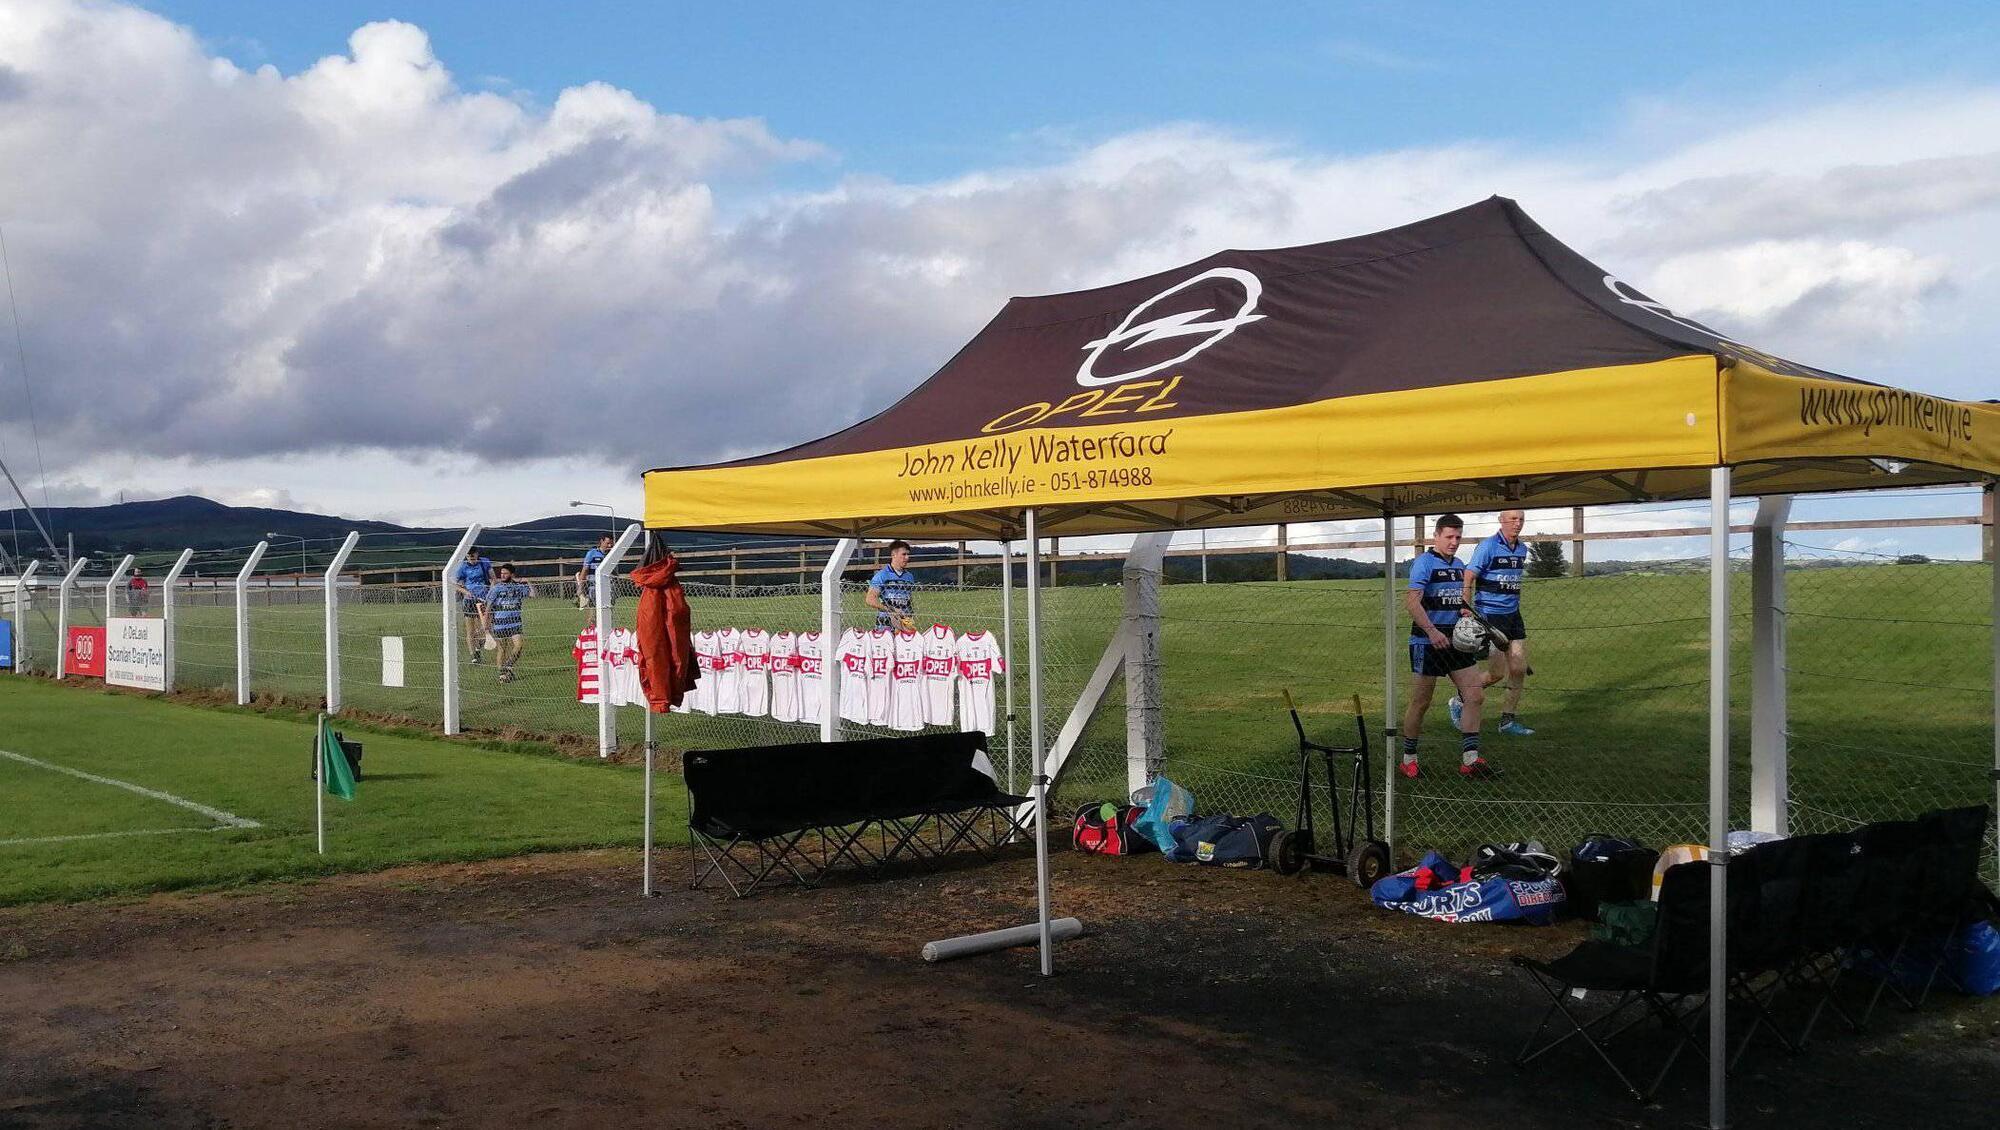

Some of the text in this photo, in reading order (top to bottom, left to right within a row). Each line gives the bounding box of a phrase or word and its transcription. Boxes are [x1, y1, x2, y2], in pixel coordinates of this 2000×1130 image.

[981, 376, 1184, 433] OPEL
[1800, 386, 1973, 450] www.johnkelly.ie
[898, 428, 1174, 478] John Kelly Waterford
[909, 475, 1036, 504] www.johnkelly.ie
[1050, 466, 1153, 492] 051-874988
[1441, 596, 1463, 605] TYRE
[925, 660, 950, 675] OPEL
